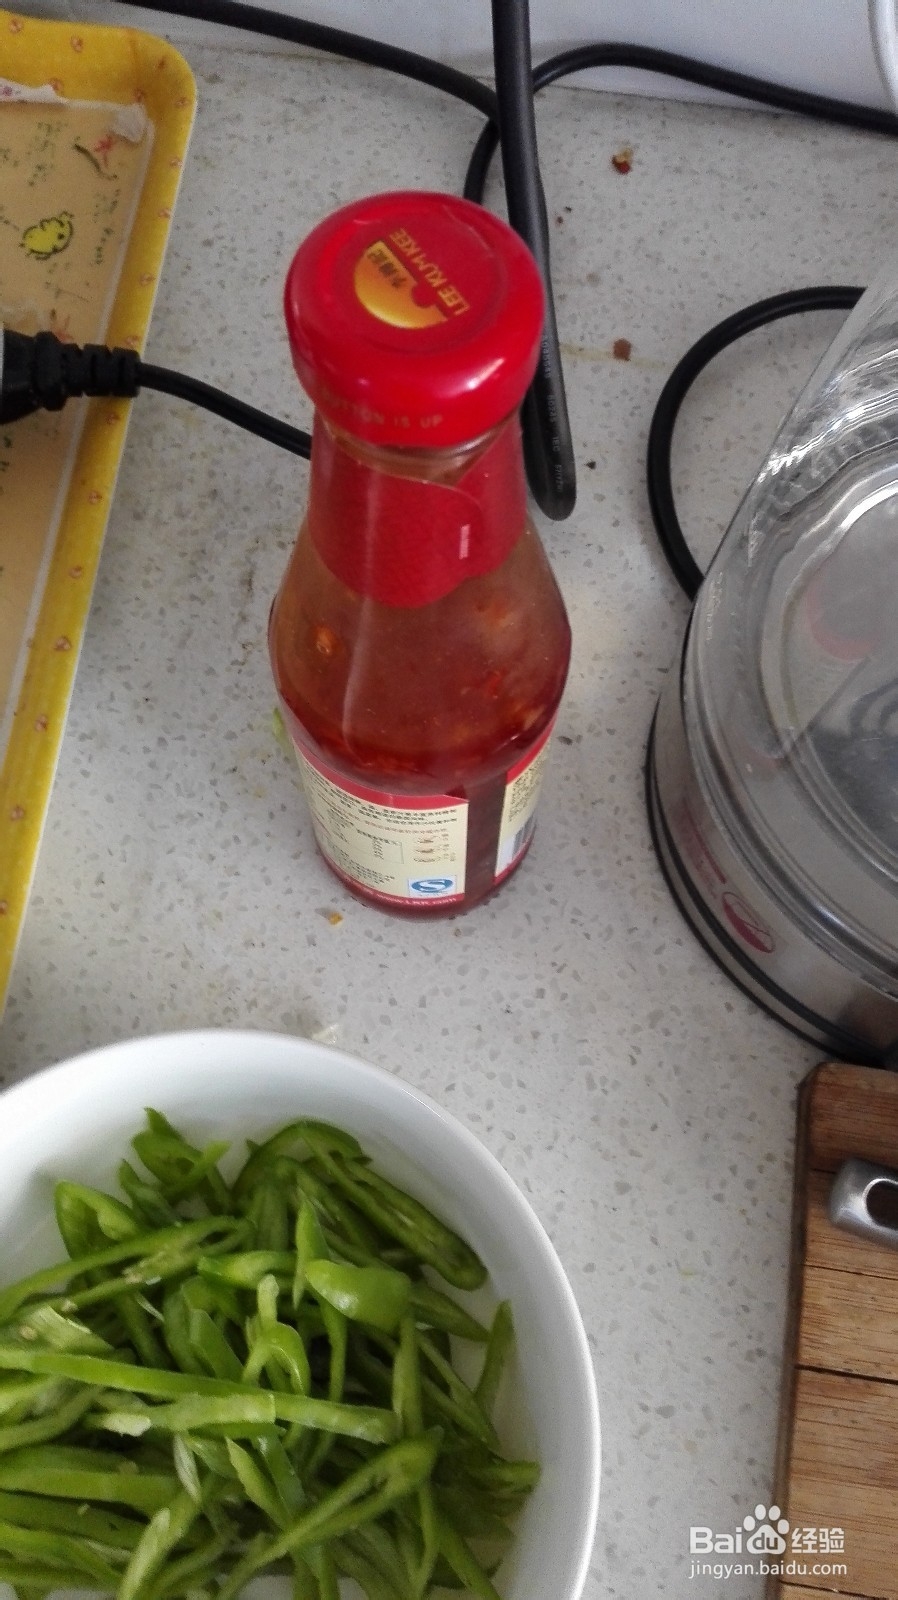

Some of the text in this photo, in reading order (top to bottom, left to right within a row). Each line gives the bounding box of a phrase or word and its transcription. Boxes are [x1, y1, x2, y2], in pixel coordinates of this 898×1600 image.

[389, 227, 470, 316] LEE KUM KEE
[394, 415, 411, 429] IS
[420, 414, 443, 429] UP
